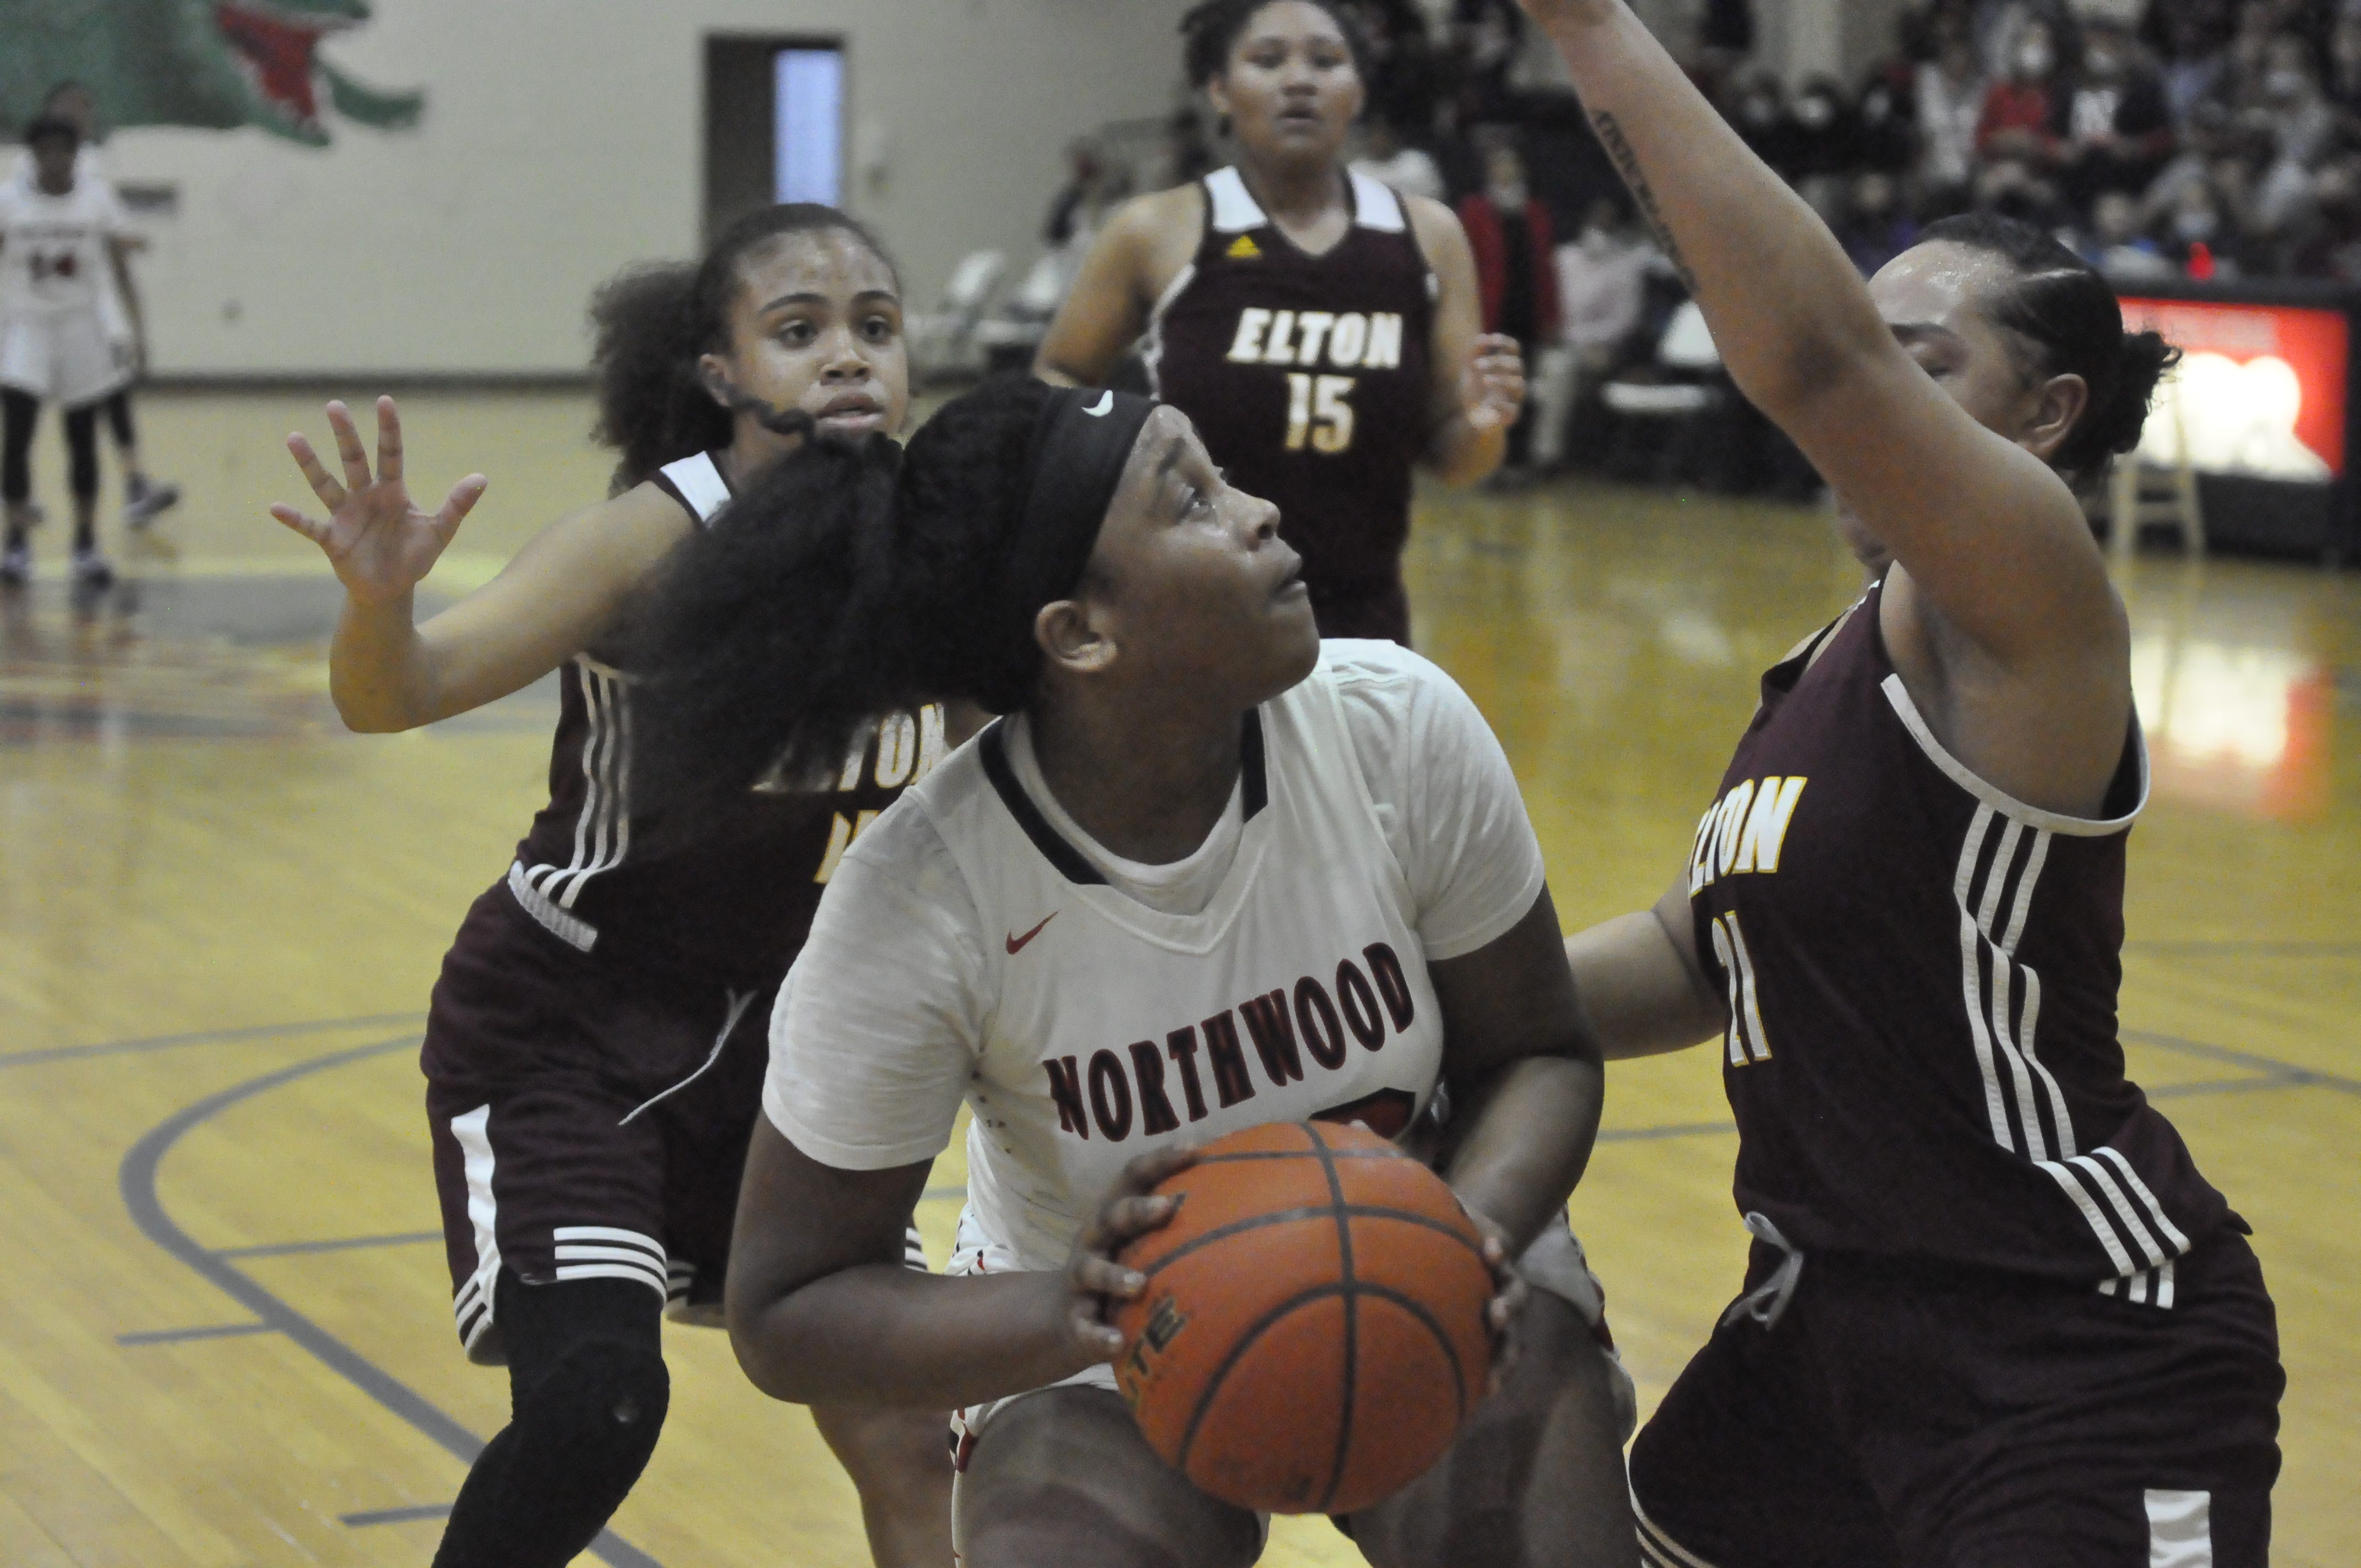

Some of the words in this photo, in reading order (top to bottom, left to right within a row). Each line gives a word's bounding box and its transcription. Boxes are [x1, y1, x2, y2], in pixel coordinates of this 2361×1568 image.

[1226, 307, 1403, 369] ELTON
[1283, 373, 1356, 453] 15
[1042, 941, 1415, 1142] NORTHWOOD
[1712, 910, 1772, 1068] 21
